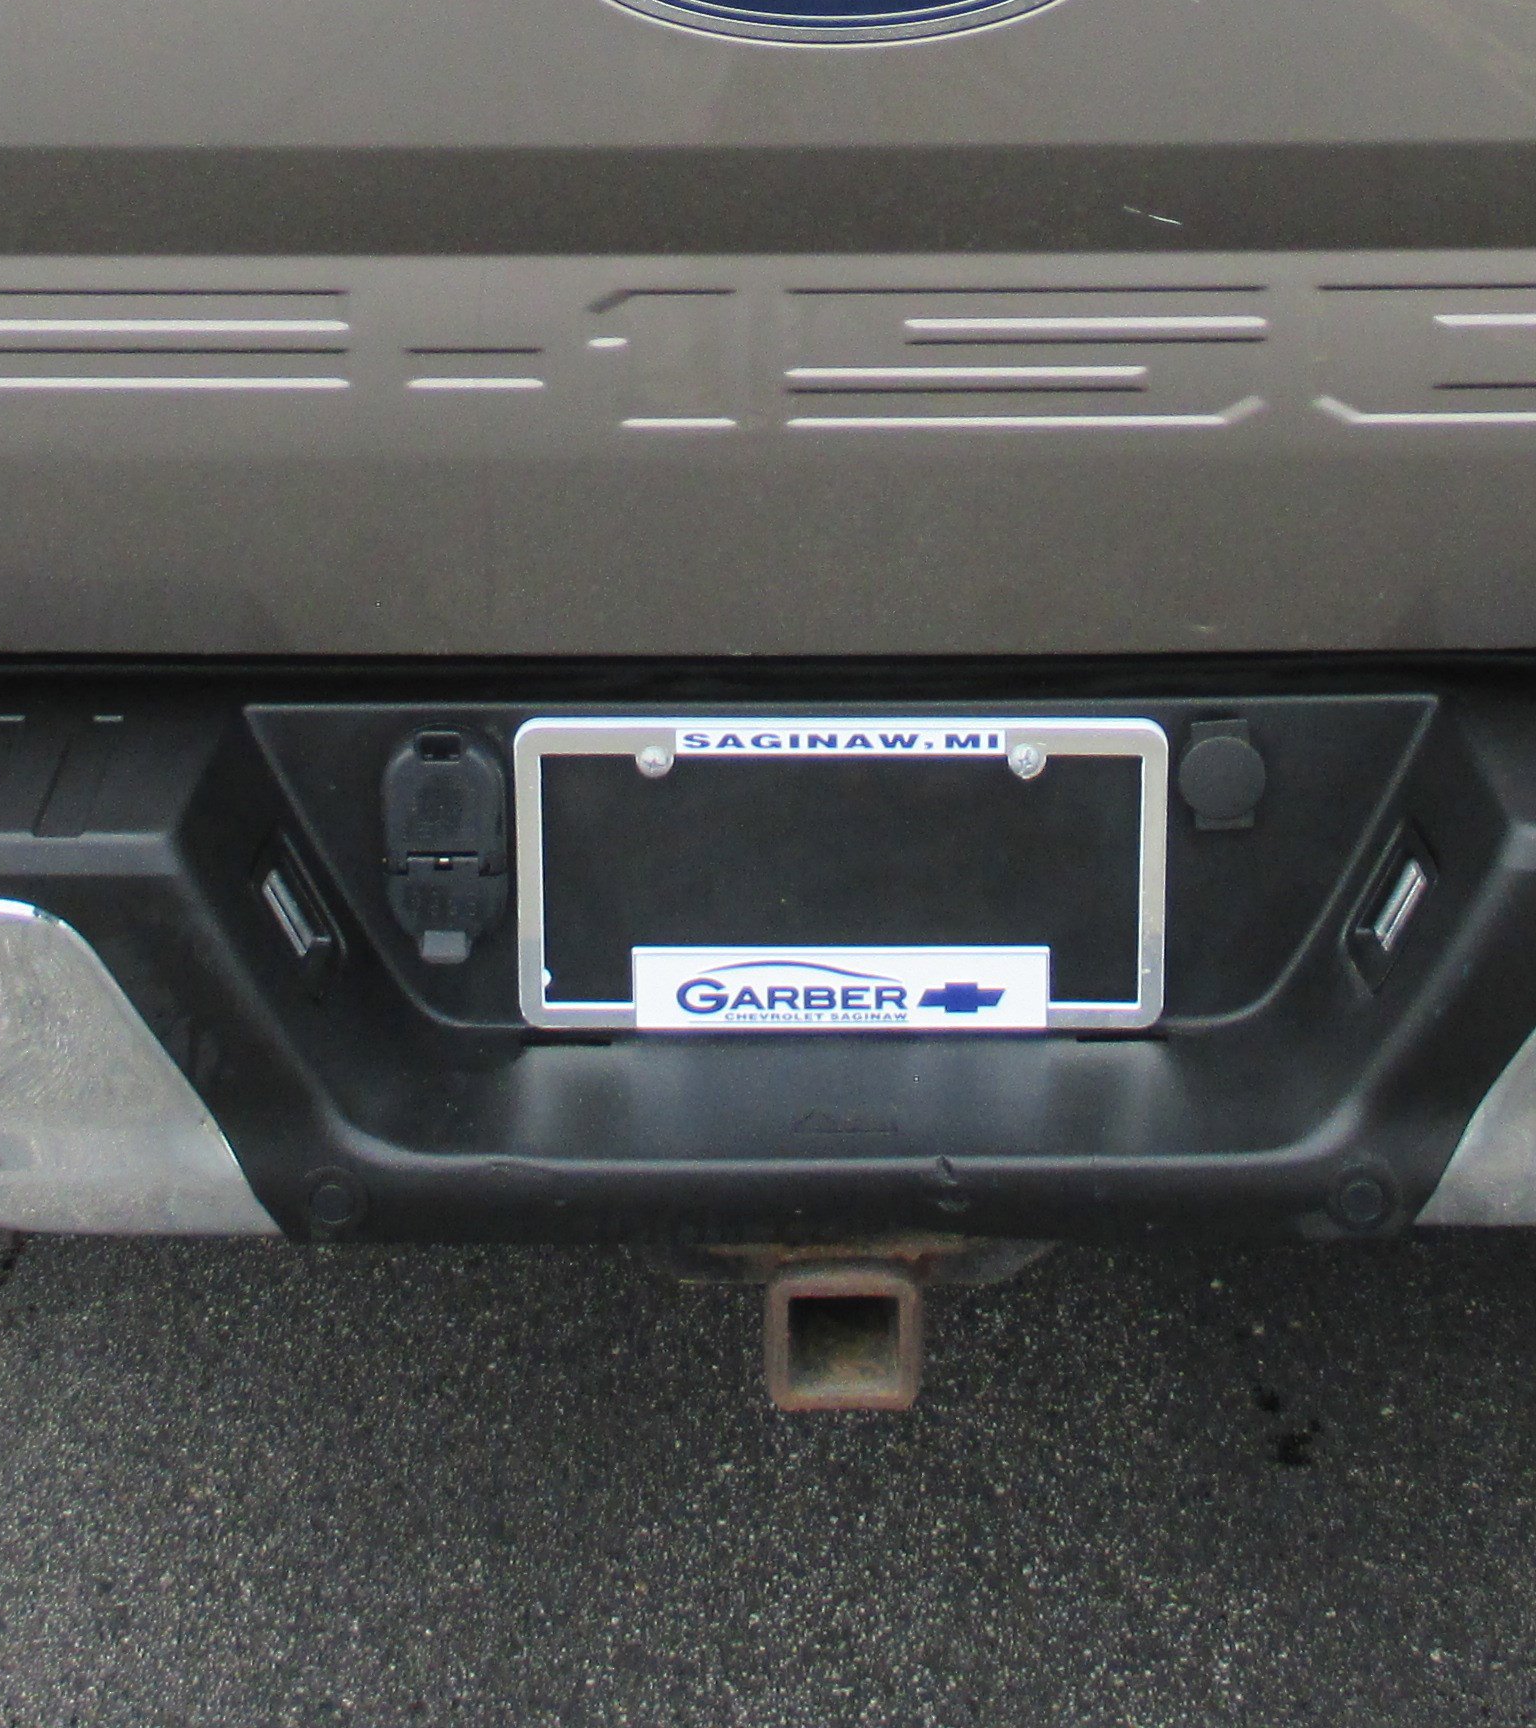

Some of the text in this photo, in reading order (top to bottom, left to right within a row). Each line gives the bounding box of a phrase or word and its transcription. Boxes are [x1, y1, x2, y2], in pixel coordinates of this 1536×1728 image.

[676, 977, 908, 1015] GARBER
[724, 1012, 909, 1022] CHEVROLET SAGINAW
